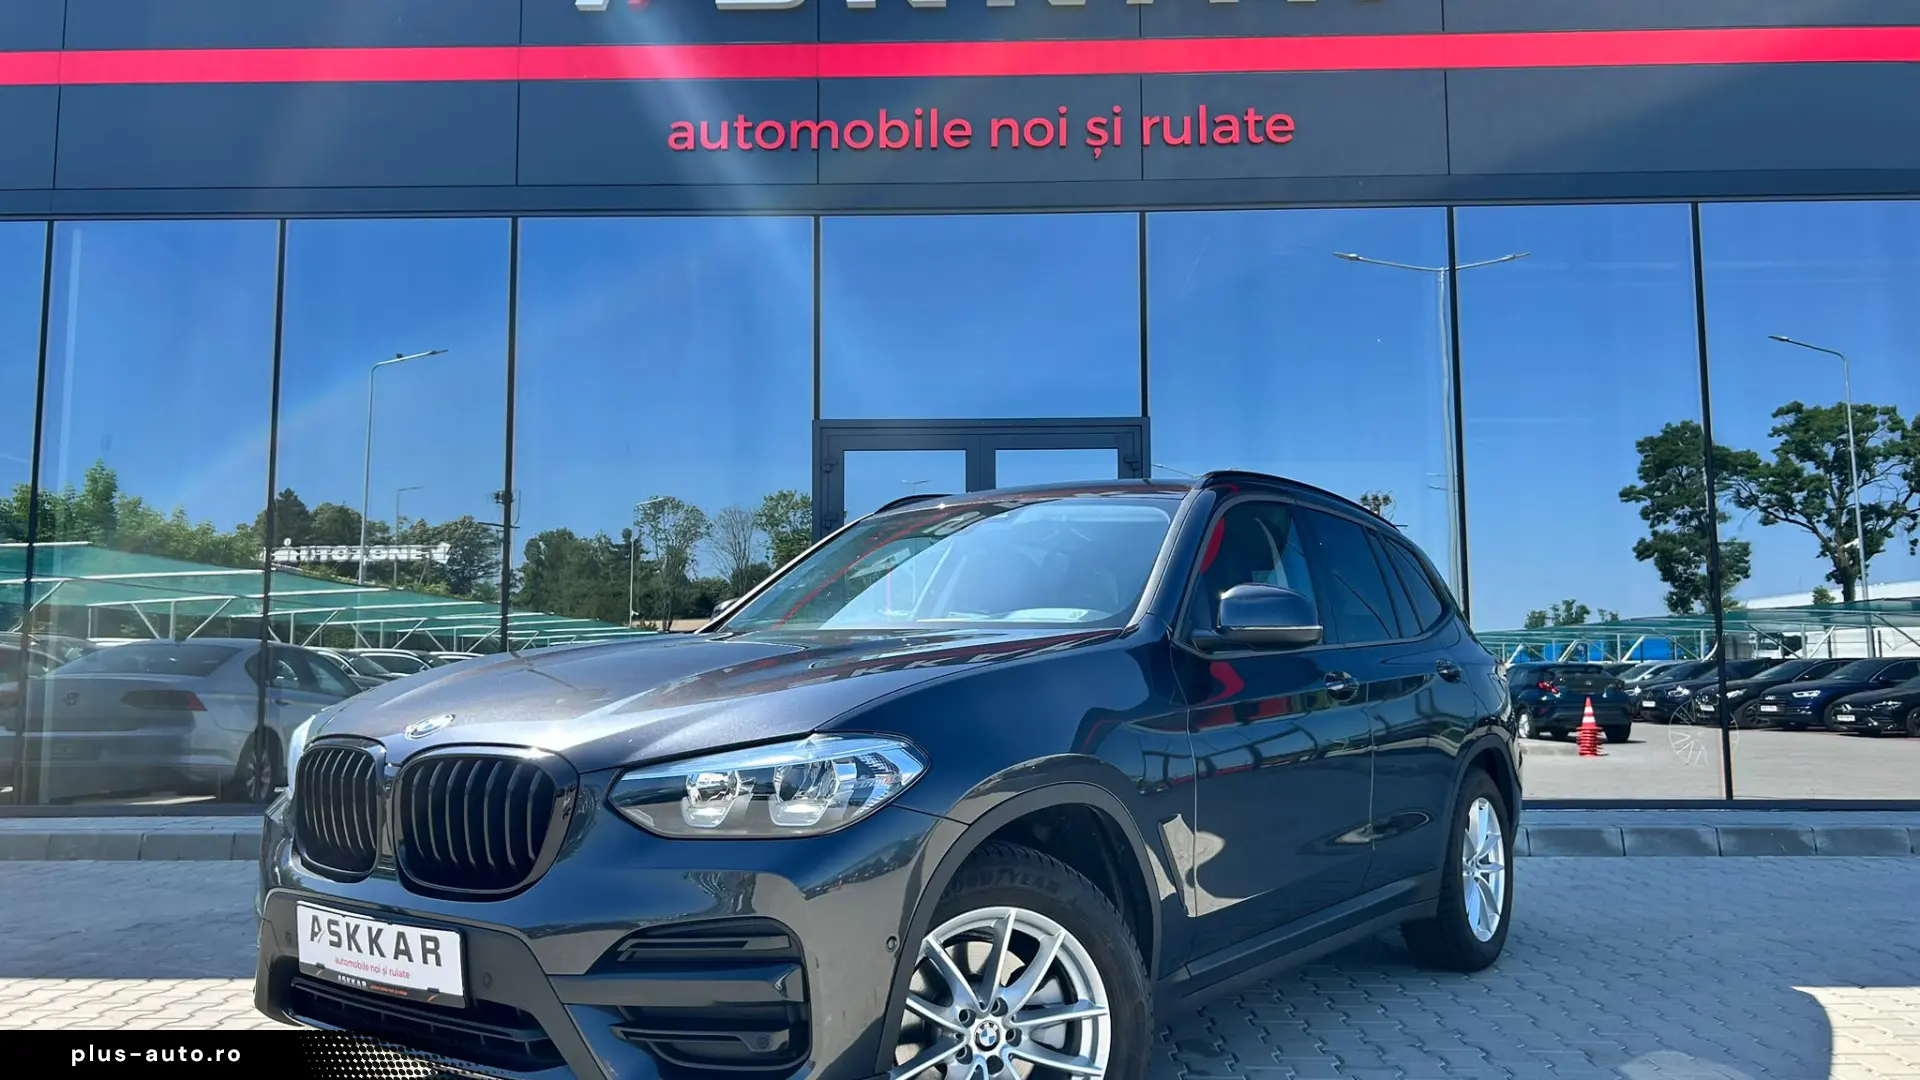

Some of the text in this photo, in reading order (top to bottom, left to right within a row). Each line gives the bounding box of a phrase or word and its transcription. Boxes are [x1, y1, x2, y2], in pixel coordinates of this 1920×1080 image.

[667, 104, 1296, 159] automobile noi și rulate
[310, 914, 442, 967] ASKKAR
[335, 956, 370, 972] automobile
